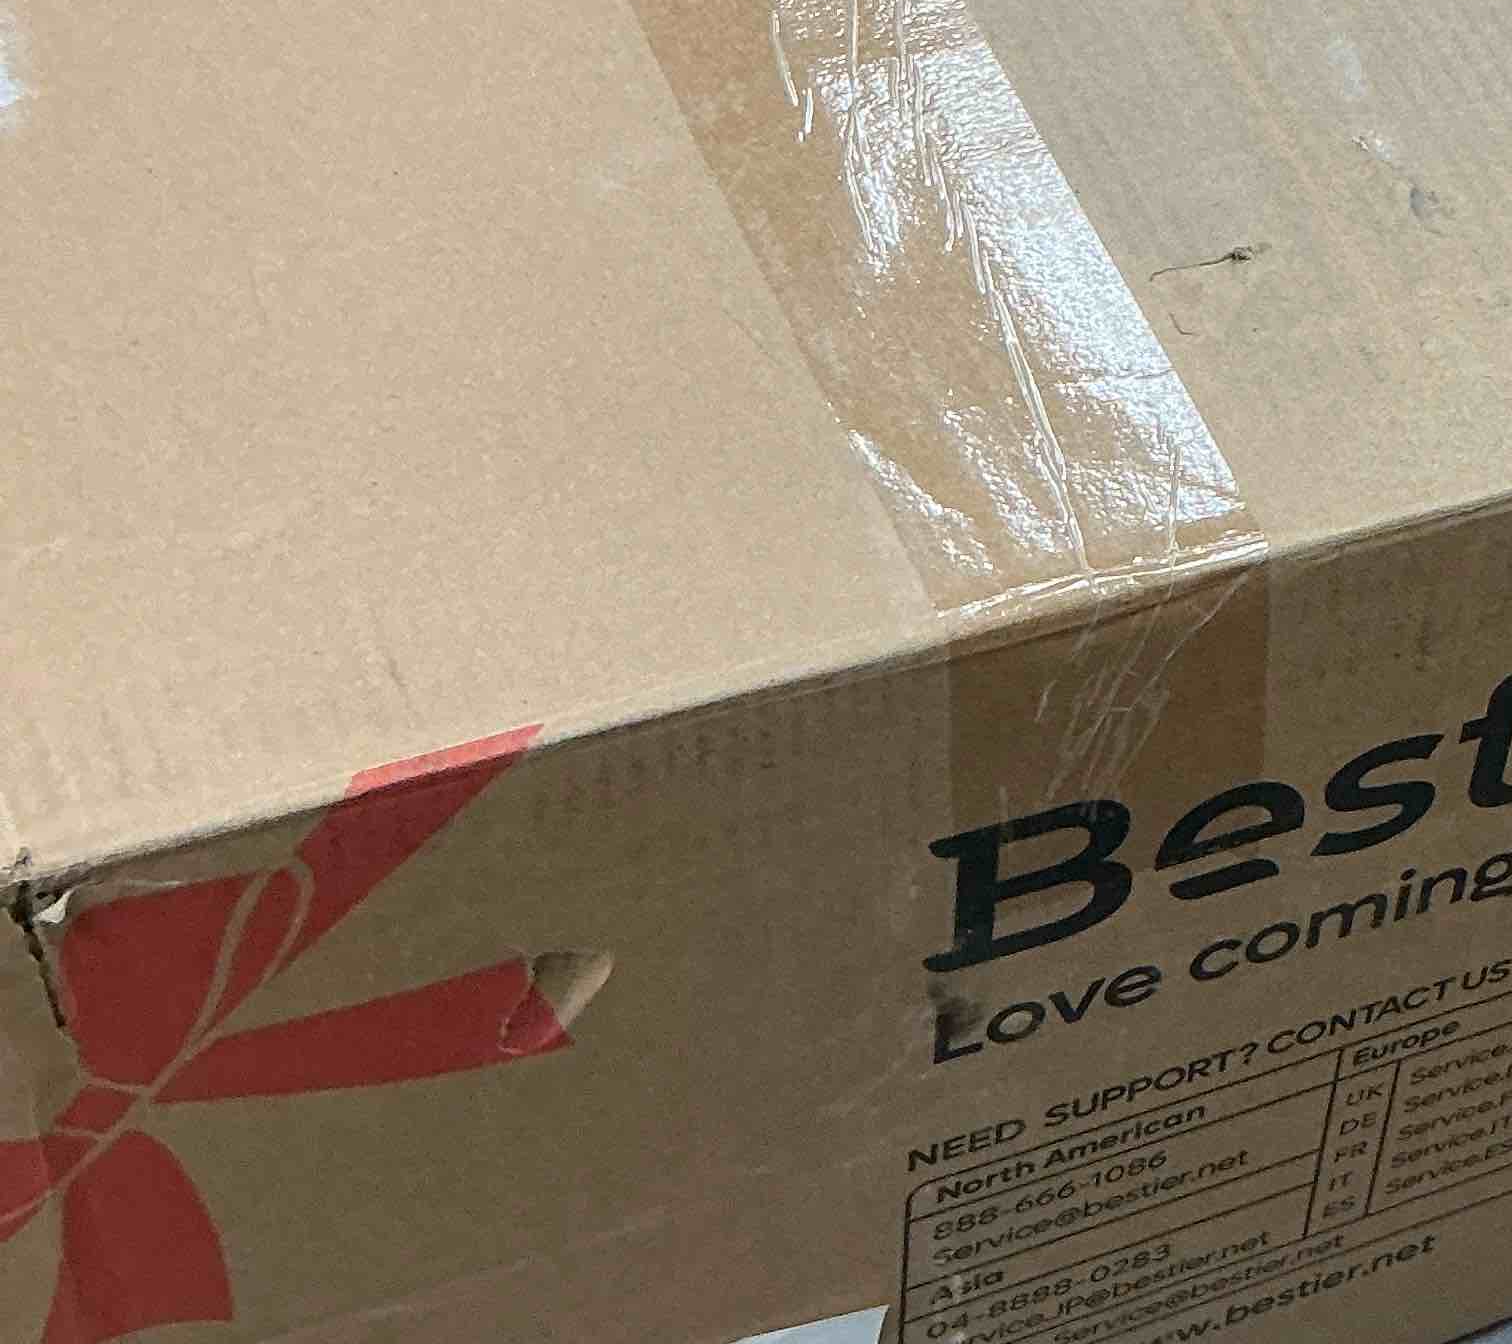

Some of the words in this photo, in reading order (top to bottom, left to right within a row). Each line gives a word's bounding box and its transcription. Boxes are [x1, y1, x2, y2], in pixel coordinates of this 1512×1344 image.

[933, 964, 1161, 1065] Love
[1353, 1019, 1461, 1067] Europe
[907, 1119, 1026, 1172] NEED
[1043, 1040, 1256, 1129] SUPPORT?
[1264, 975, 1456, 1056] CONTACT
[1463, 959, 1512, 991] US
[1345, 1081, 1385, 1108] UK
[1338, 1112, 1378, 1137] DE
[935, 1162, 1036, 1204] North
[1043, 1105, 1206, 1169] American
[1332, 1140, 1368, 1164] FR
[932, 1151, 1169, 1241] 888-666-1086
[1327, 1171, 1354, 1193] IT
[931, 1149, 1250, 1266] Service@bestier.net
[1322, 1196, 1356, 1220] ES
[930, 1268, 1005, 1307] Asia
